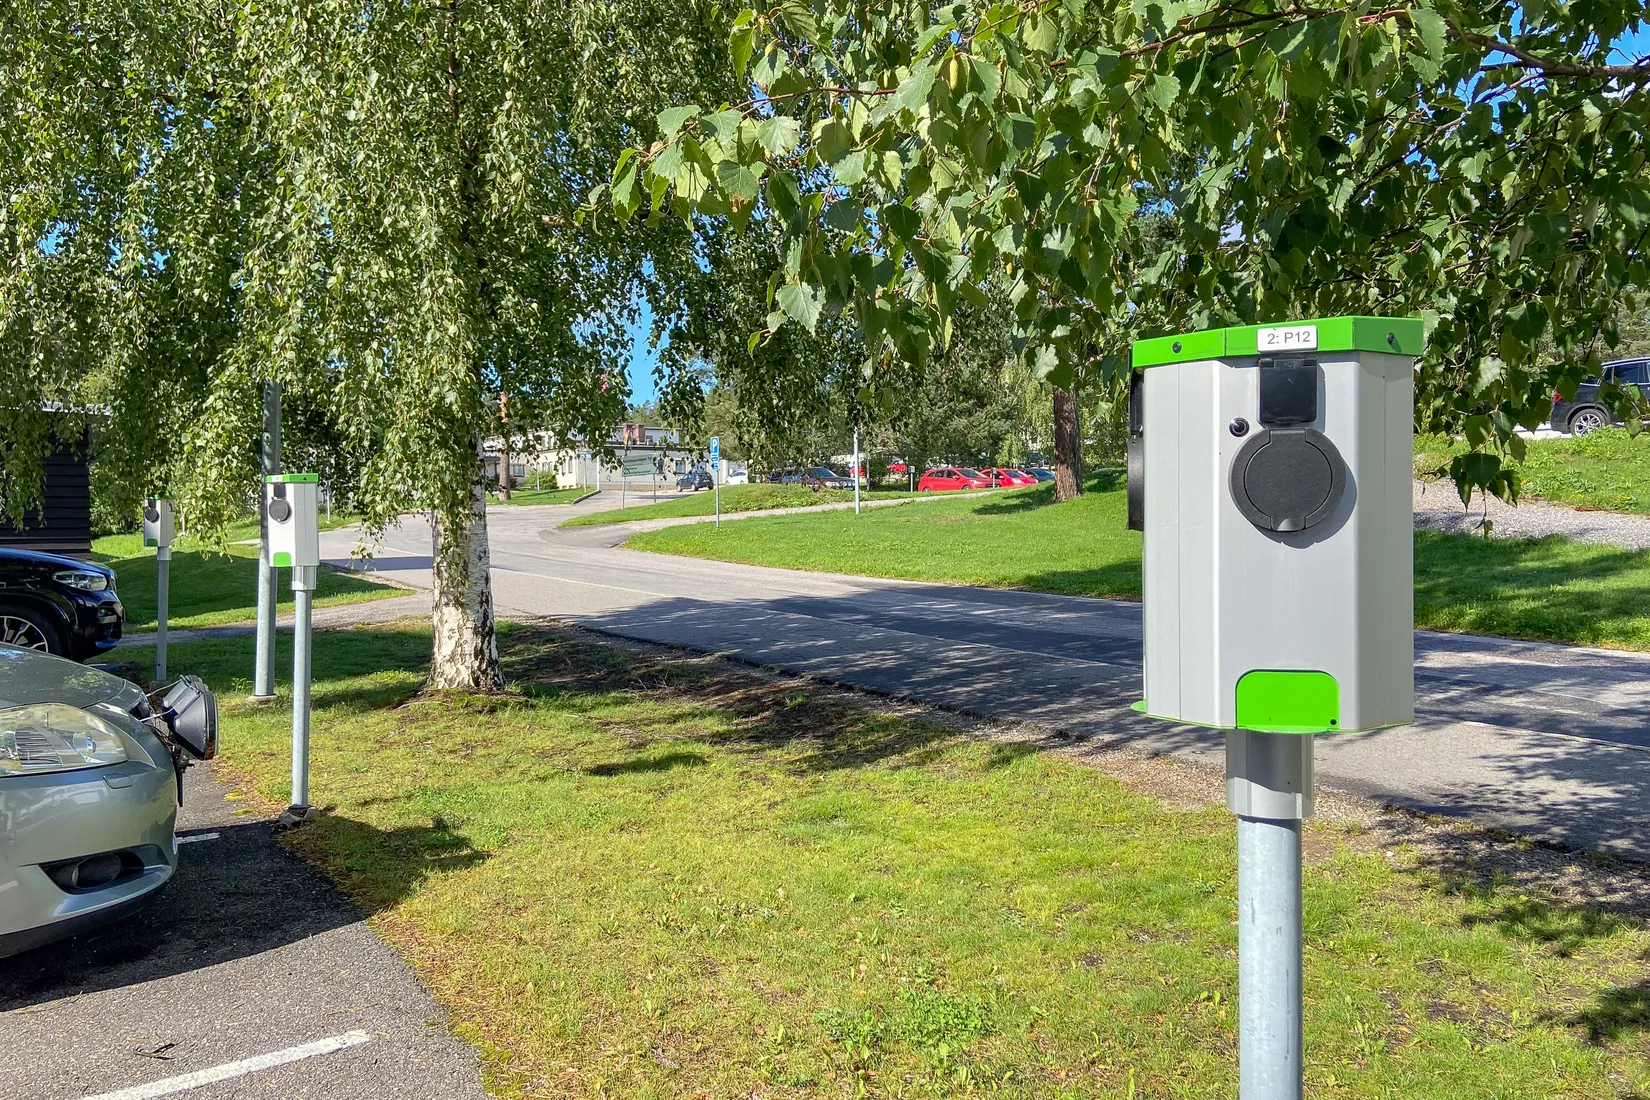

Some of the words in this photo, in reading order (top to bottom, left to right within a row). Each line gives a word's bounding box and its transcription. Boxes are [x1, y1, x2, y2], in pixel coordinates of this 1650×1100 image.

[1267, 333, 1280, 345] 2:
[1284, 331, 1311, 343] P12
[712, 438, 718, 452] P
